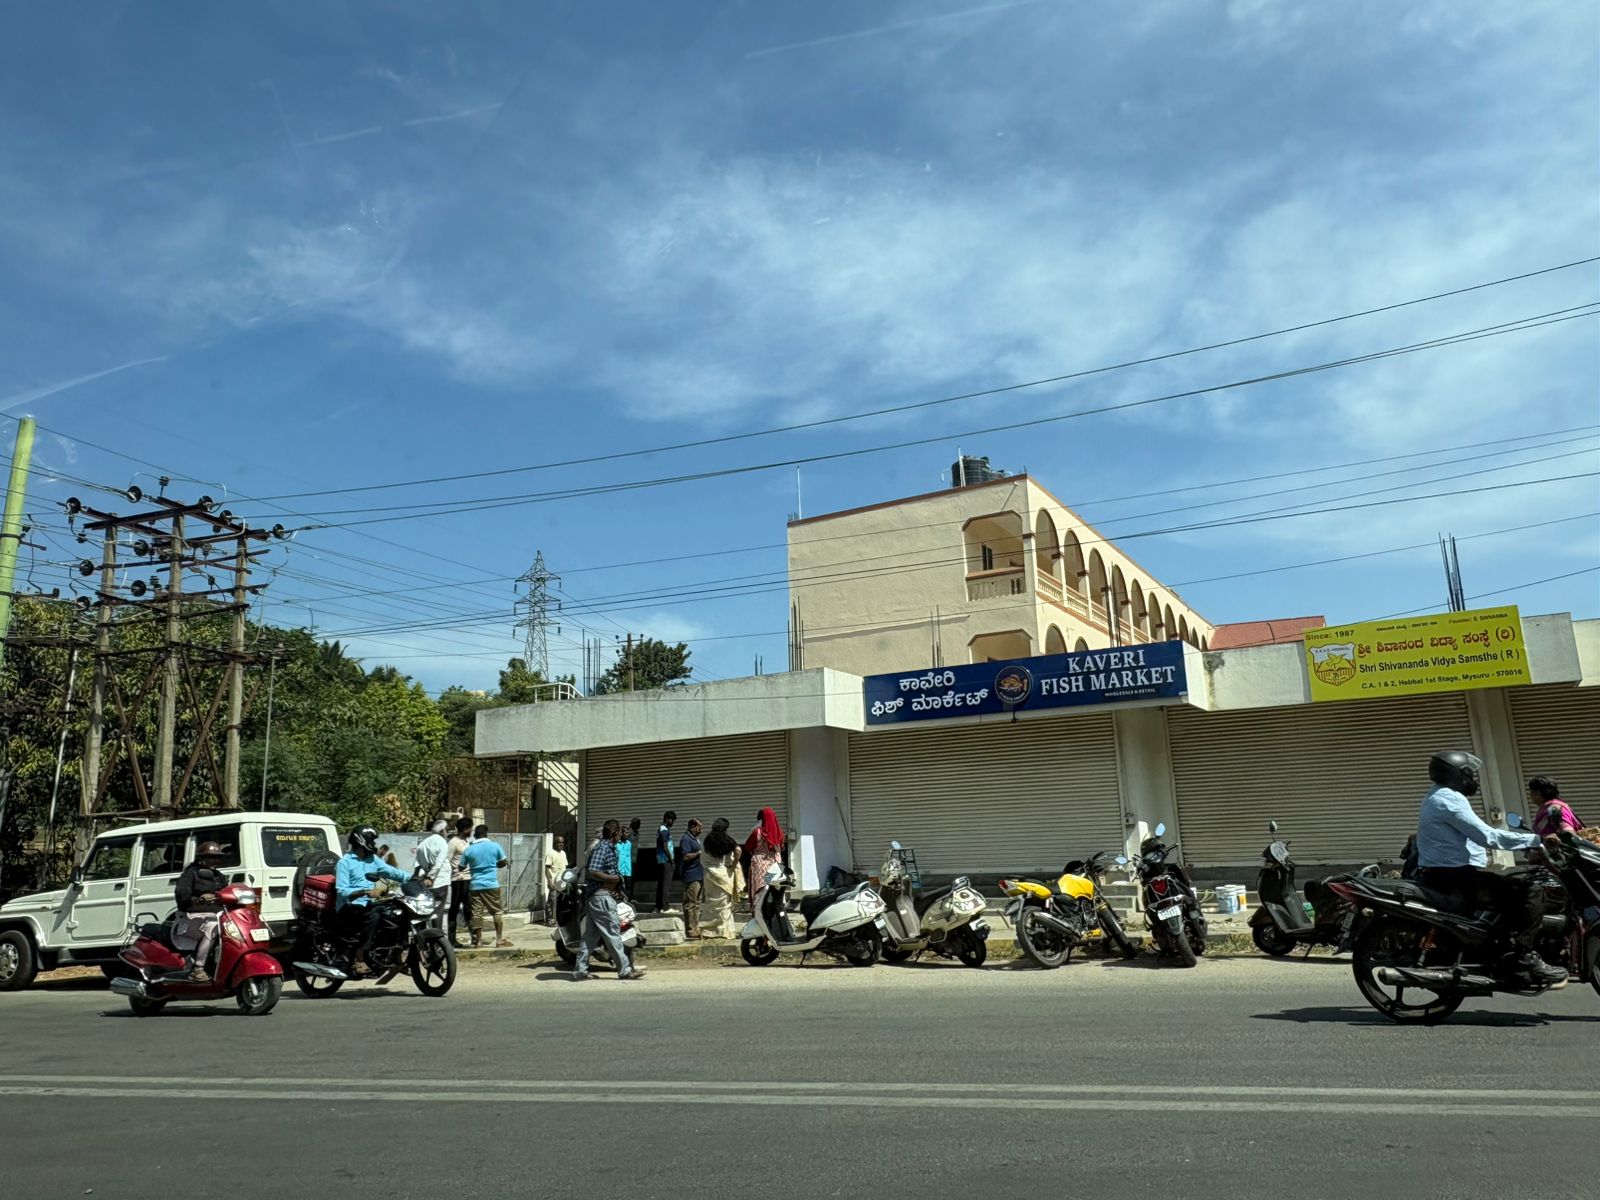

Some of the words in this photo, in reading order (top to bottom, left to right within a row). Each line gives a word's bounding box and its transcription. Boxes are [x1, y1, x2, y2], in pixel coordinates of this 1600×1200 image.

[1334, 630, 1354, 638] 1987
[1357, 643, 1371, 658] ಶ್ರೀ
[1376, 638, 1424, 653] ಶಿವಾನಂದ
[1462, 629, 1490, 648] ಸಂಸ್ಥೆ
[1067, 649, 1146, 674] KAVERI
[1359, 663, 1377, 673] Shri
[1378, 659, 1429, 671] Shivananda
[1430, 655, 1456, 668] Vidya
[1458, 651, 1498, 664] Samsthe
[899, 670, 956, 691] ಕಾವೇರಿ
[1040, 677, 1085, 696] FISH
[1090, 666, 1176, 691] MARKET
[1462, 672, 1490, 681] Mysuru
[871, 697, 905, 717] ಫಿಶ್
[911, 688, 989, 712] ಮಾರ್ಕೆಟ್
